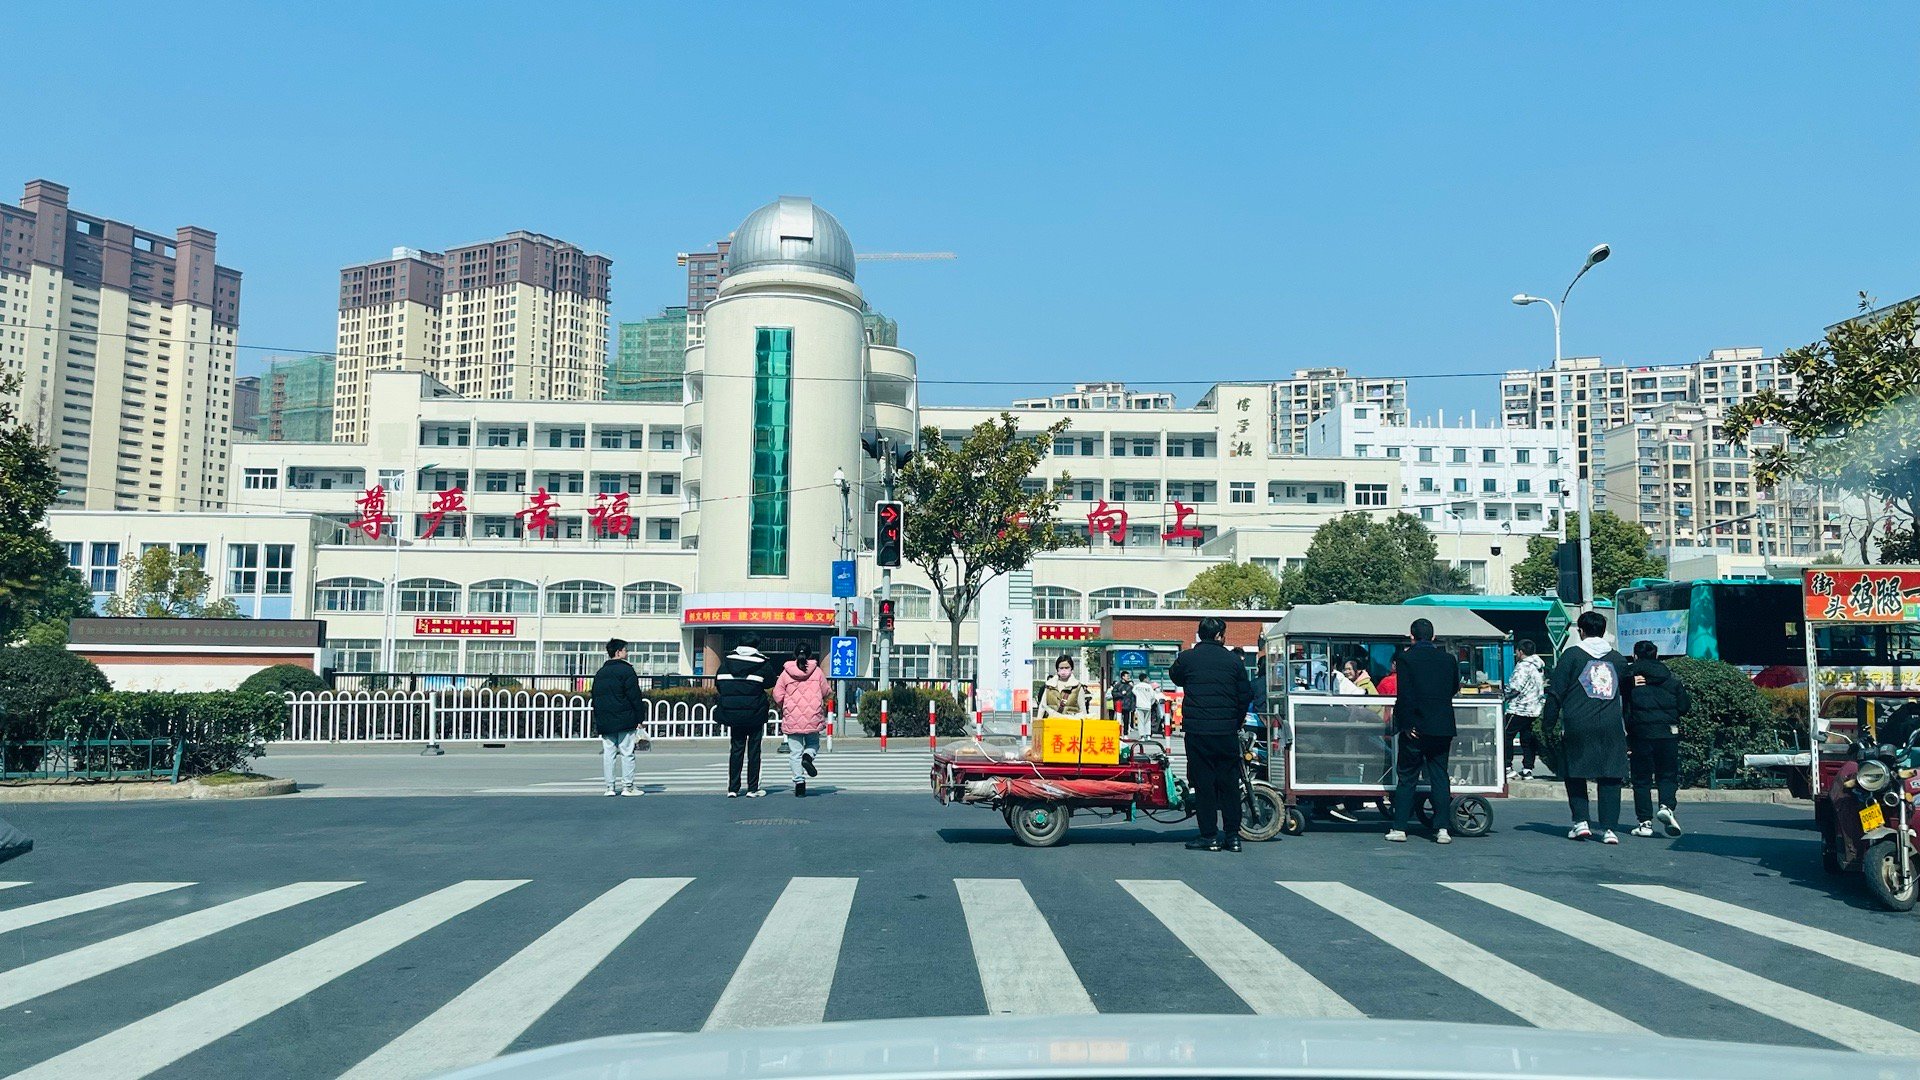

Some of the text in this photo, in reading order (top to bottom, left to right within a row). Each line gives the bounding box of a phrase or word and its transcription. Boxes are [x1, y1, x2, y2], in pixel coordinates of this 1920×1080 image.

[516, 487, 635, 541] 幸福
[1086, 498, 1204, 543] 向上
[888, 528, 897, 541] 4
[886, 618, 893, 630] 3
[1001, 616, 1013, 679] 六安第二中学
[832, 648, 842, 676] 人快走
[845, 648, 854, 676] 车让人
[1051, 734, 1116, 756] 香米发糕
